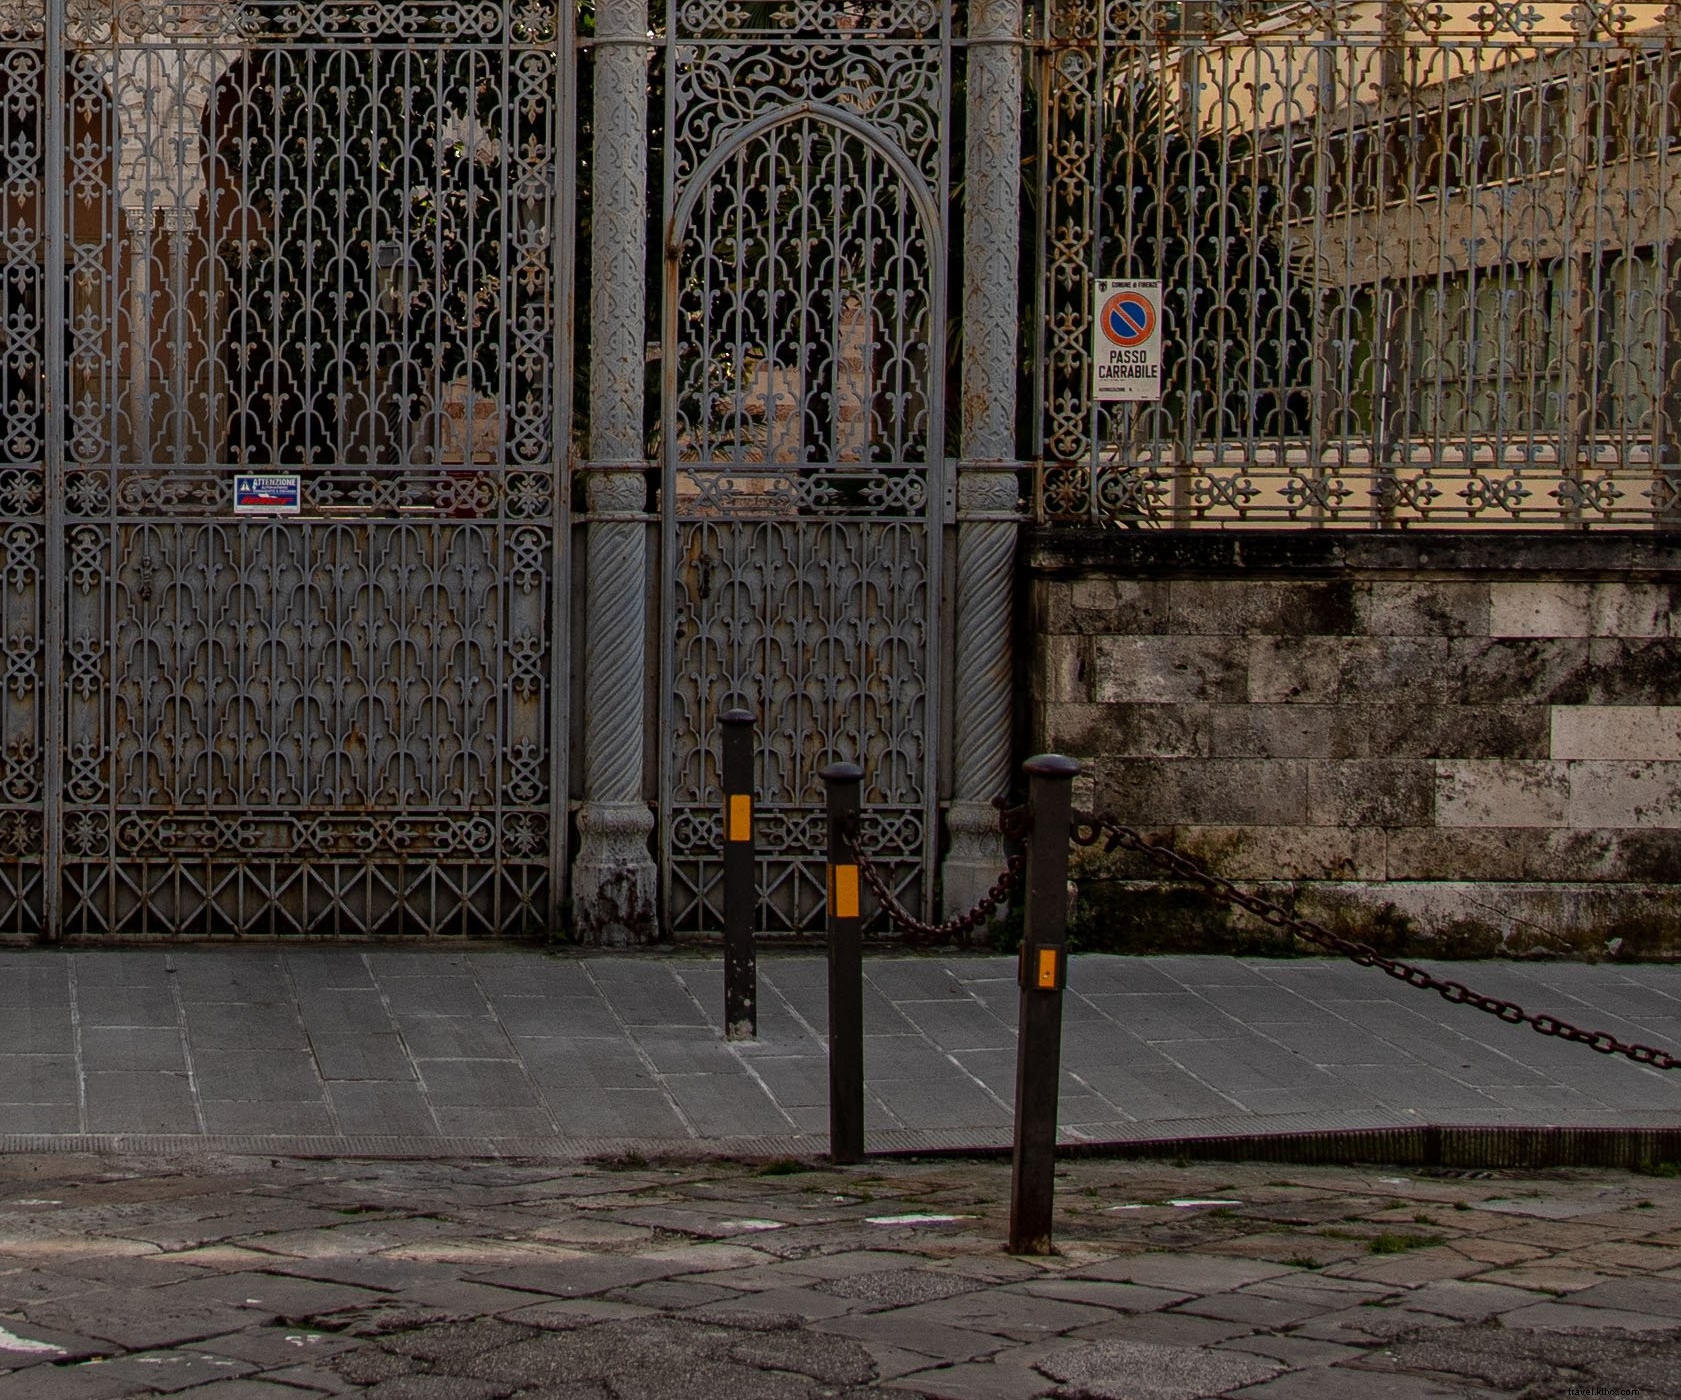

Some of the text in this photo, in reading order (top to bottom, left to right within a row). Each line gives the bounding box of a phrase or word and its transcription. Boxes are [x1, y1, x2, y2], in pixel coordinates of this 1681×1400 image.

[1110, 350, 1147, 364] PASSO
[1098, 365, 1158, 378] CARRABILE
[252, 478, 297, 487] ATTENZIONE
